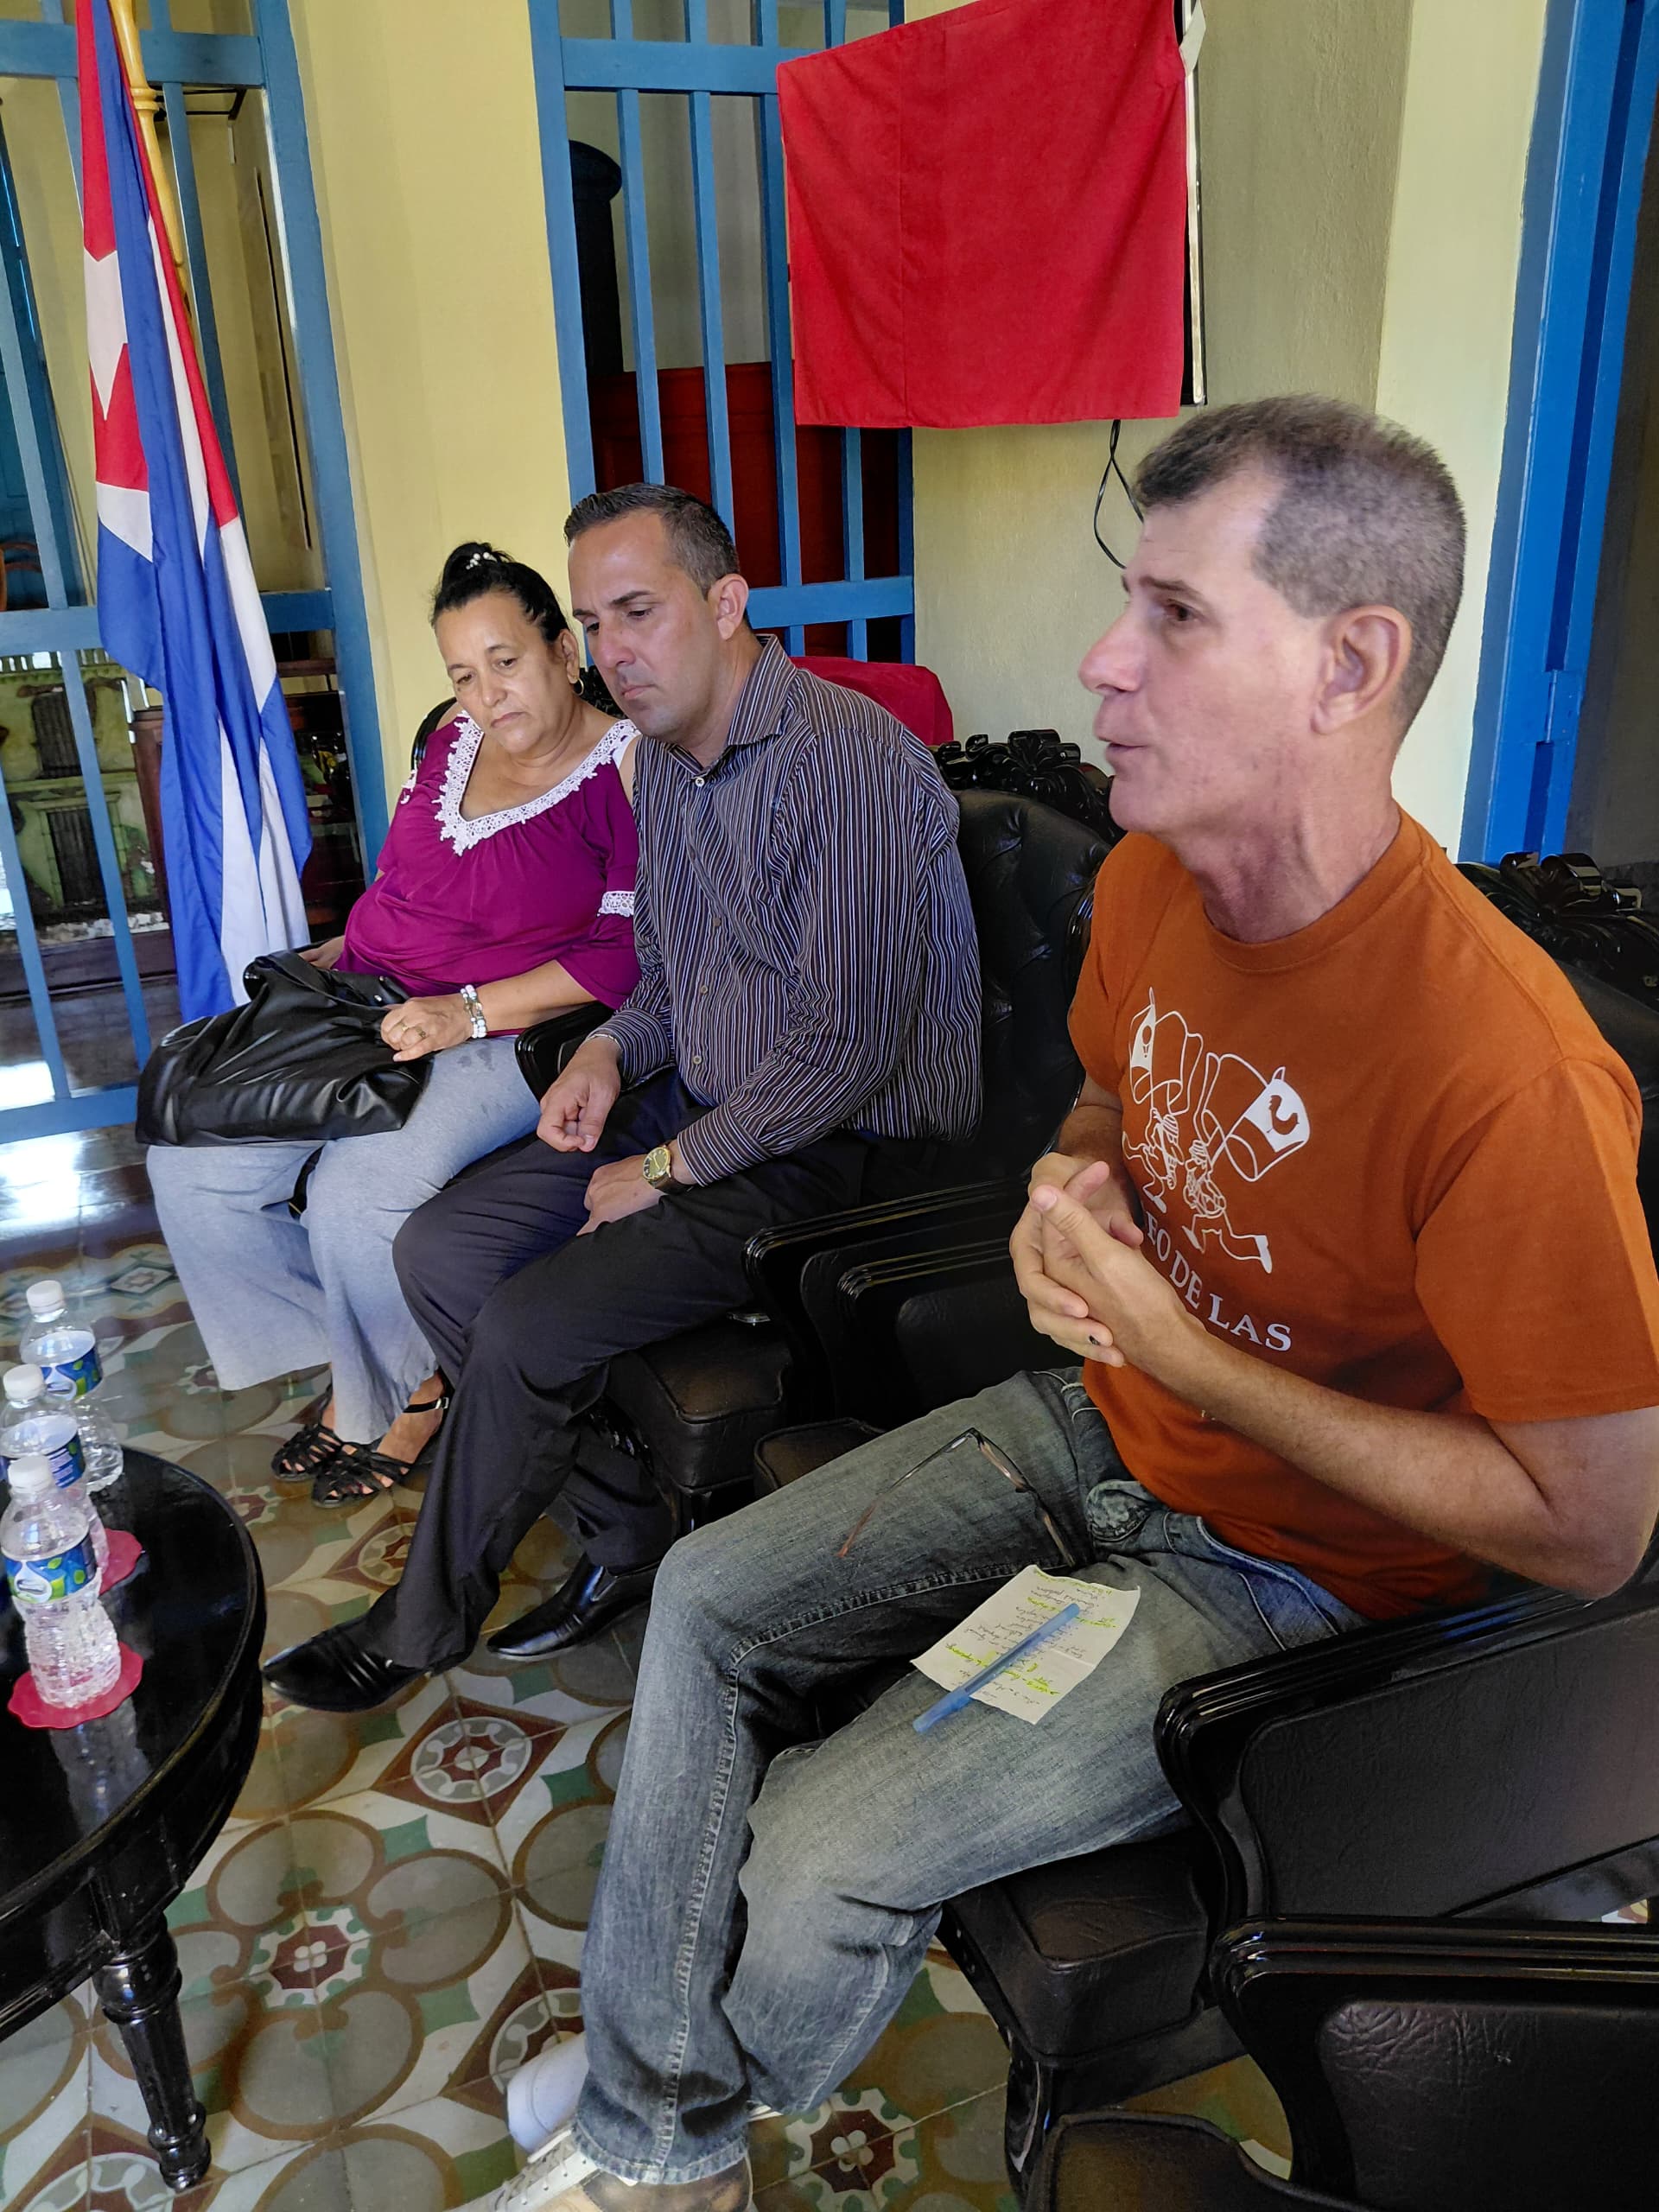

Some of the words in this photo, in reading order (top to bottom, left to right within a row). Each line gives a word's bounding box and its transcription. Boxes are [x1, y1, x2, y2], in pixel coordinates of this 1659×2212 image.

[1143, 1207, 1171, 1262] EO
[1169, 1249, 1203, 1310] DE
[1208, 1293, 1292, 1351] LAS
